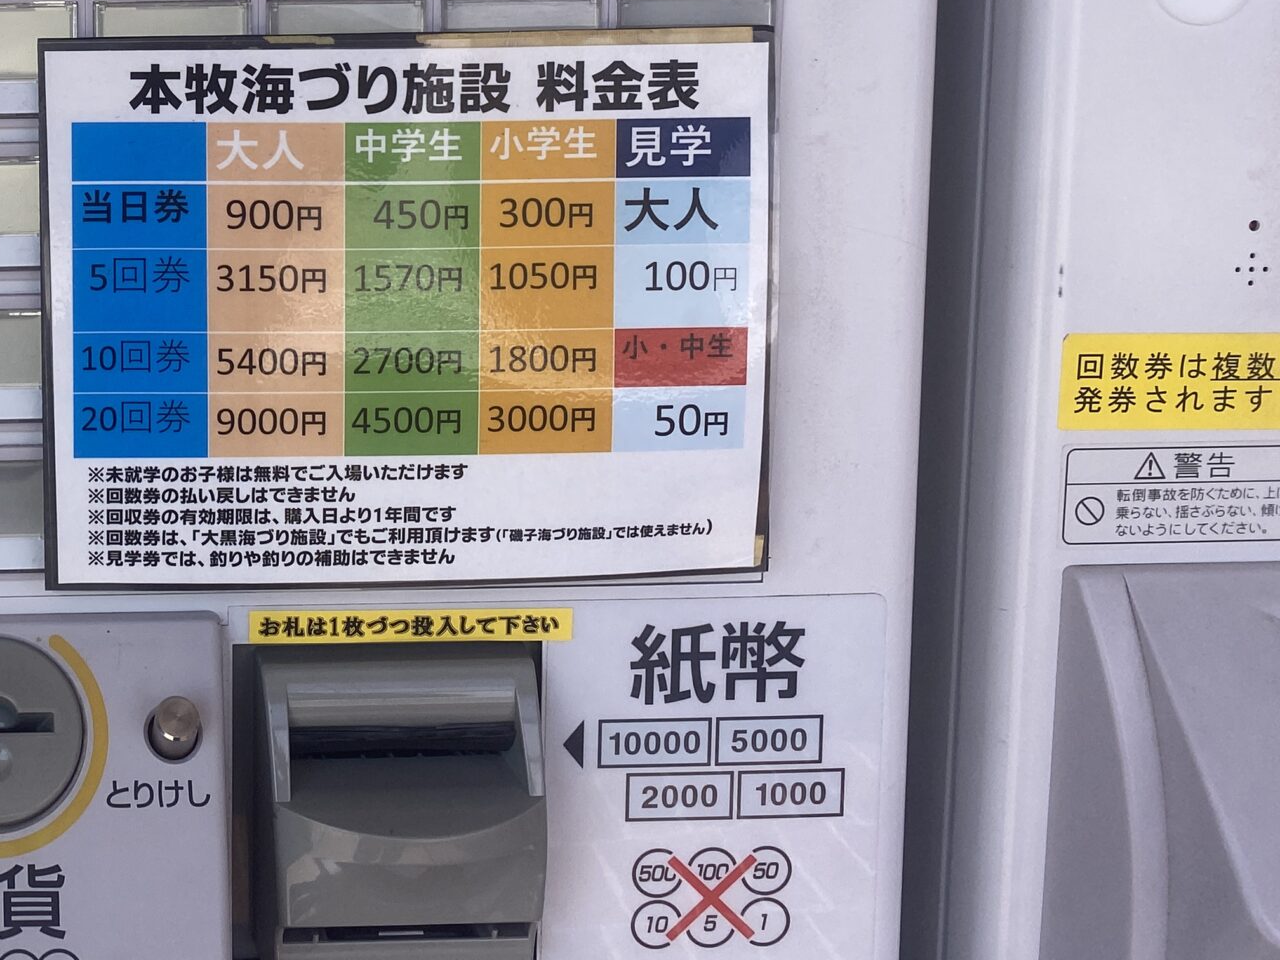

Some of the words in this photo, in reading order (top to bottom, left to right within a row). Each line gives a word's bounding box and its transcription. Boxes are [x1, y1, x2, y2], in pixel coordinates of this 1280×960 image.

[129, 62, 512, 115] 本牧海づり施設
[537, 58, 701, 112] 料金表
[215, 129, 306, 171] 大人
[354, 126, 464, 164] 中学生
[489, 126, 598, 162] 小学生
[625, 124, 713, 168] 見学
[81, 188, 190, 225] 当日券
[225, 198, 323, 232] 900円
[373, 197, 470, 231] 450円
[499, 195, 594, 228] 300円
[623, 186, 719, 232] 大人
[88, 256, 192, 294] 5回券
[215, 263, 327, 294] 3150円
[354, 261, 464, 294] 1570円
[489, 260, 598, 291] 1050円
[643, 259, 738, 293] 100円
[80, 340, 192, 373] 10回券
[215, 345, 327, 377] 5400円
[352, 344, 463, 377] 2700円
[488, 343, 597, 375] 1800円
[622, 333, 733, 360] 小・中生
[1076, 351, 1280, 381] 回数券は複数
[1073, 384, 1273, 413] 発券されます
[80, 399, 192, 434] 20回券
[215, 405, 327, 437] 9000円
[351, 404, 463, 436] 4500円
[487, 402, 596, 434] 3000円
[653, 402, 729, 437] 50円
[87, 462, 469, 484] ※未就学のお子様は無料でご入場いただけます
[1173, 451, 1236, 479] 警告
[87, 486, 356, 505] ※回数券の払い戻しはできません
[87, 506, 457, 525] ※回収券の有効期限は、購入日より1年間です
[1115, 521, 1268, 538] ないようにしてください。
[87, 548, 456, 569] ※見学券では、釣りや釣りの補助はできません
[259, 613, 560, 639] お札は1枚づつ投入して下さい
[629, 620, 806, 705] 紙幣
[609, 730, 701, 756] 10000
[731, 728, 808, 753] 5000
[105, 779, 211, 809] とりけし
[641, 783, 719, 809] 2000
[755, 781, 827, 807] 1000
[697, 862, 730, 881] 100
[752, 862, 779, 880] 50
[645, 915, 669, 933] 10
[703, 915, 717, 932] 5
[760, 913, 768, 931] 1
